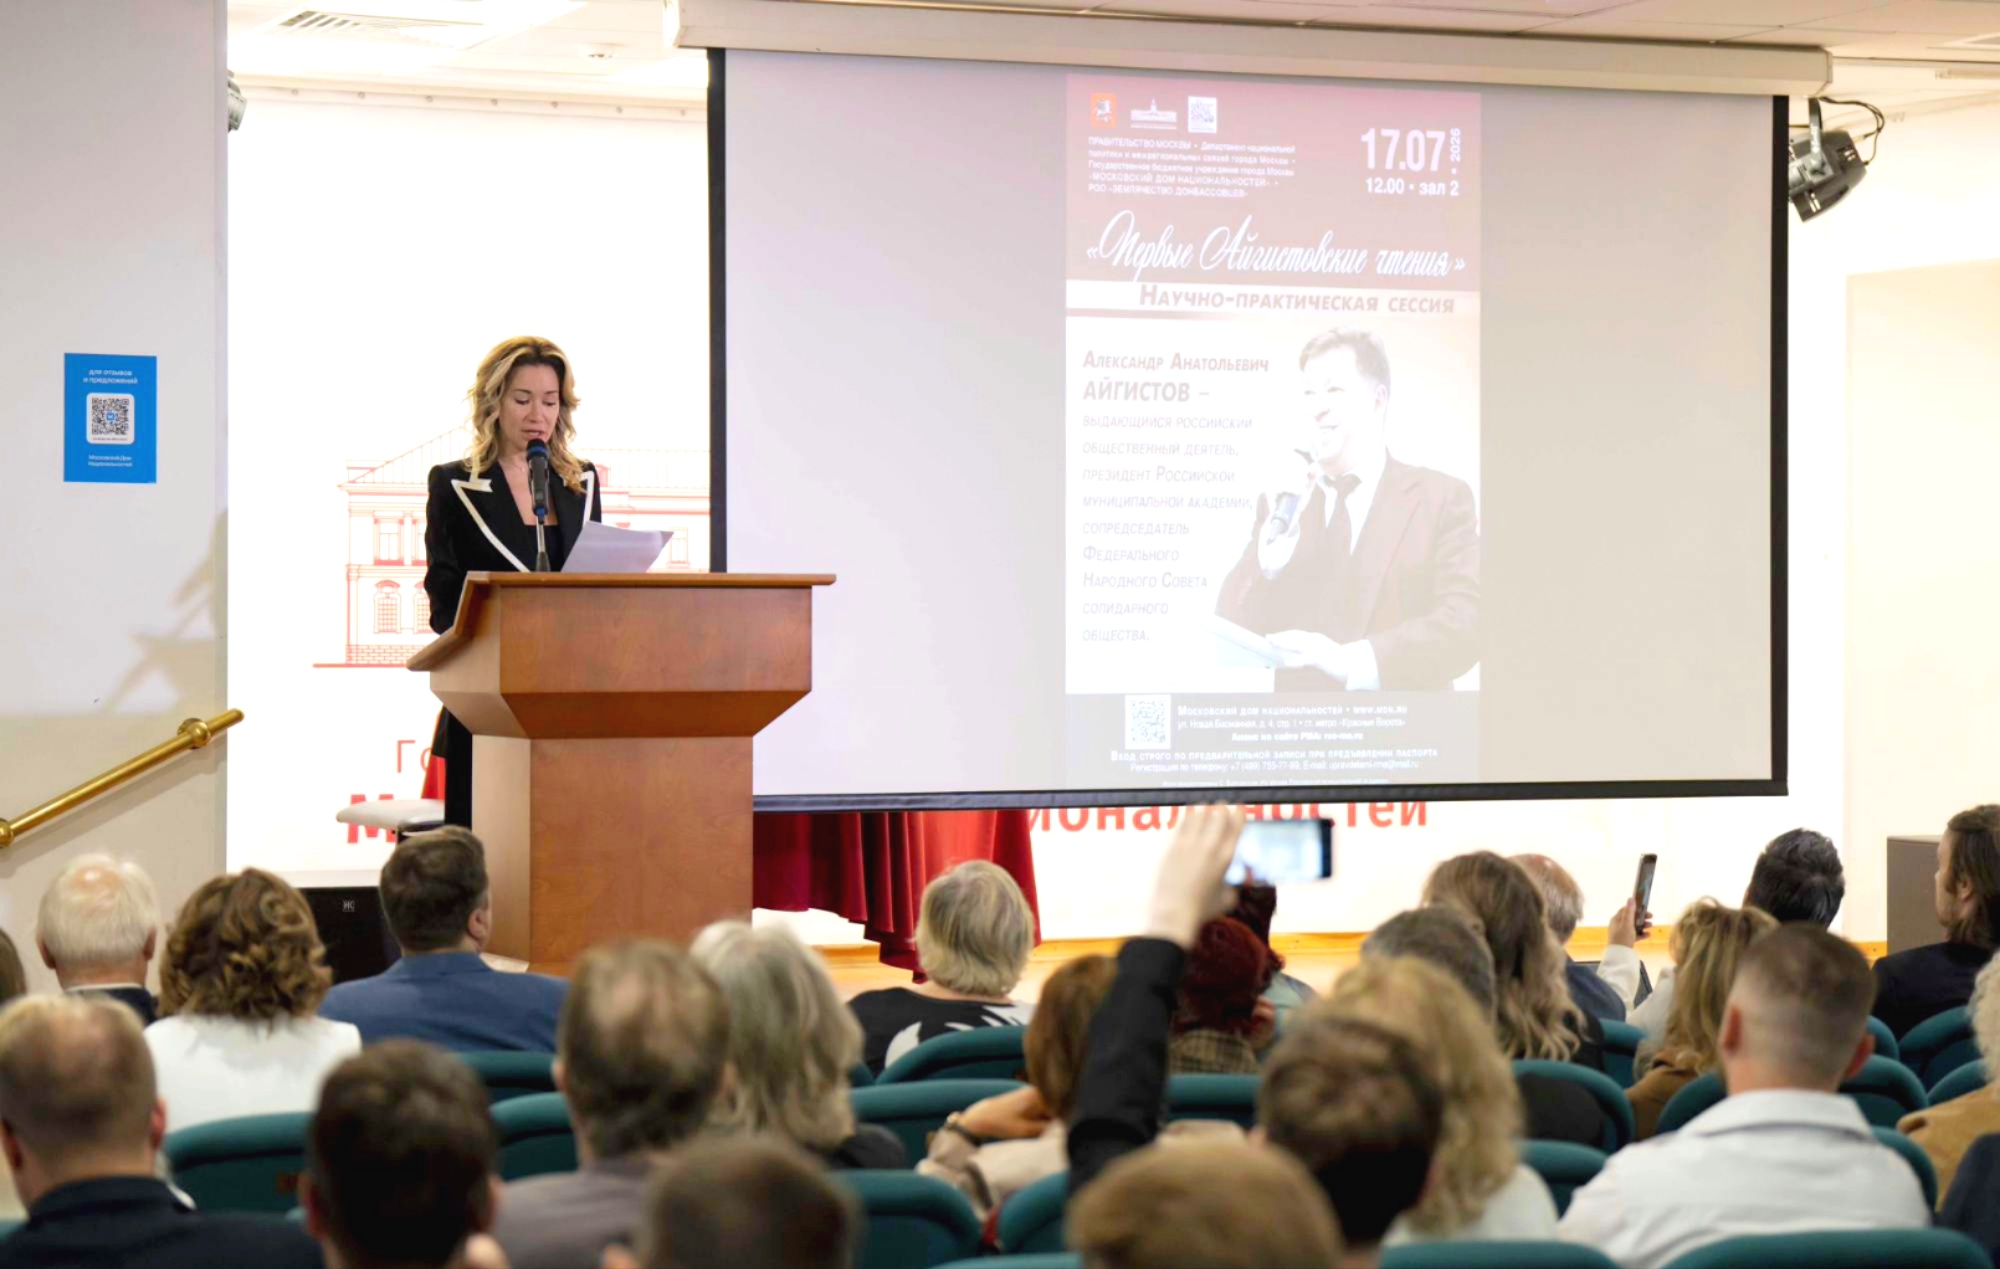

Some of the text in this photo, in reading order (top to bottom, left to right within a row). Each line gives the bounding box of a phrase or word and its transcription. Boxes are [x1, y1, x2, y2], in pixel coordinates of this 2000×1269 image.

[1361, 127, 1446, 172] 17.07
[1155, 174, 1175, 184] ДОМ
[1365, 177, 1460, 196] 12.00 зал 2
[1088, 183, 1106, 192] РОО
[1087, 209, 1194, 282] «Первые
[1200, 214, 1367, 274] Айгистовские
[89, 369, 102, 377] для
[89, 377, 138, 385] предложений
[1082, 376, 1190, 402] АЙГИСТОВ
[1083, 521, 1190, 537] СОПРЕДСЕДАТЕЛЬ
[1083, 601, 1169, 617] СОЛИДАРНОГО
